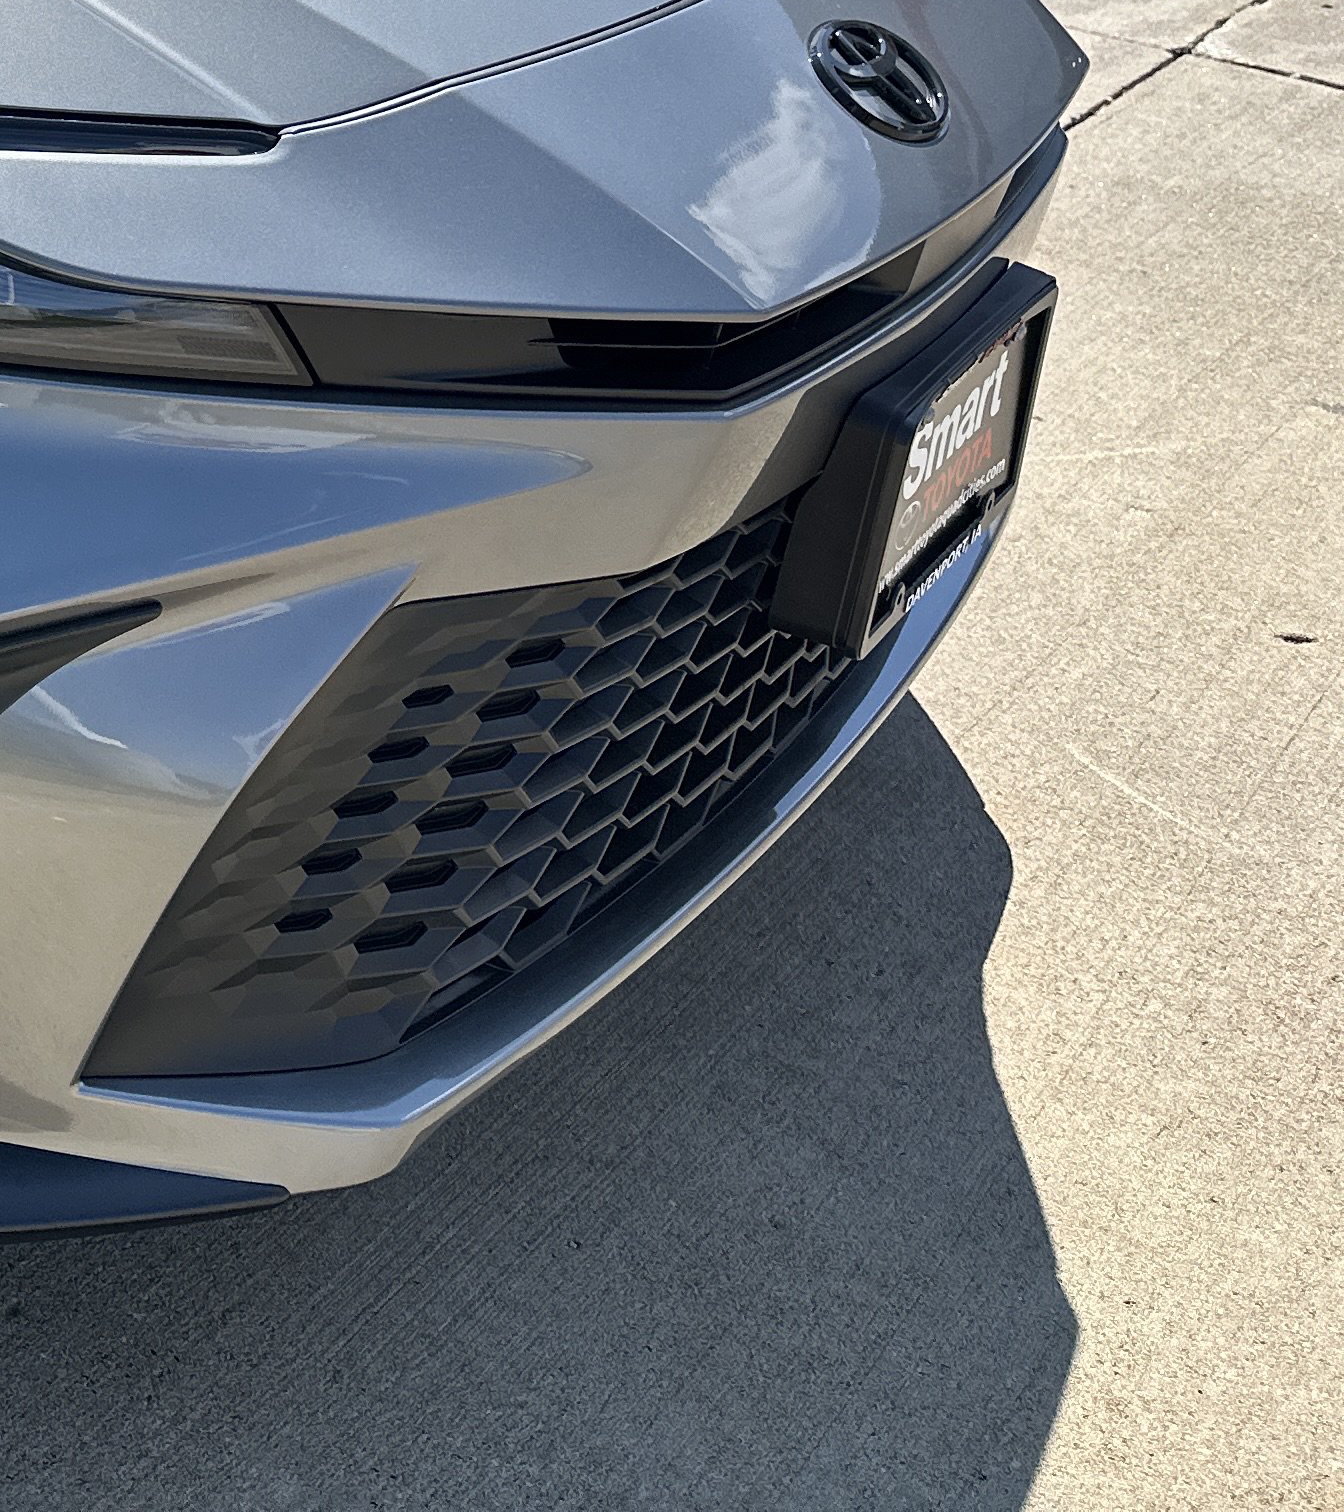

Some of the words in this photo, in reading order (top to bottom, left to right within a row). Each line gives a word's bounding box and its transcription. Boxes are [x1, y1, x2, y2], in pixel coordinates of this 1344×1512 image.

[902, 350, 1008, 499] Smart
[922, 428, 992, 522] TOYOTA
[971, 523, 983, 545] IA
